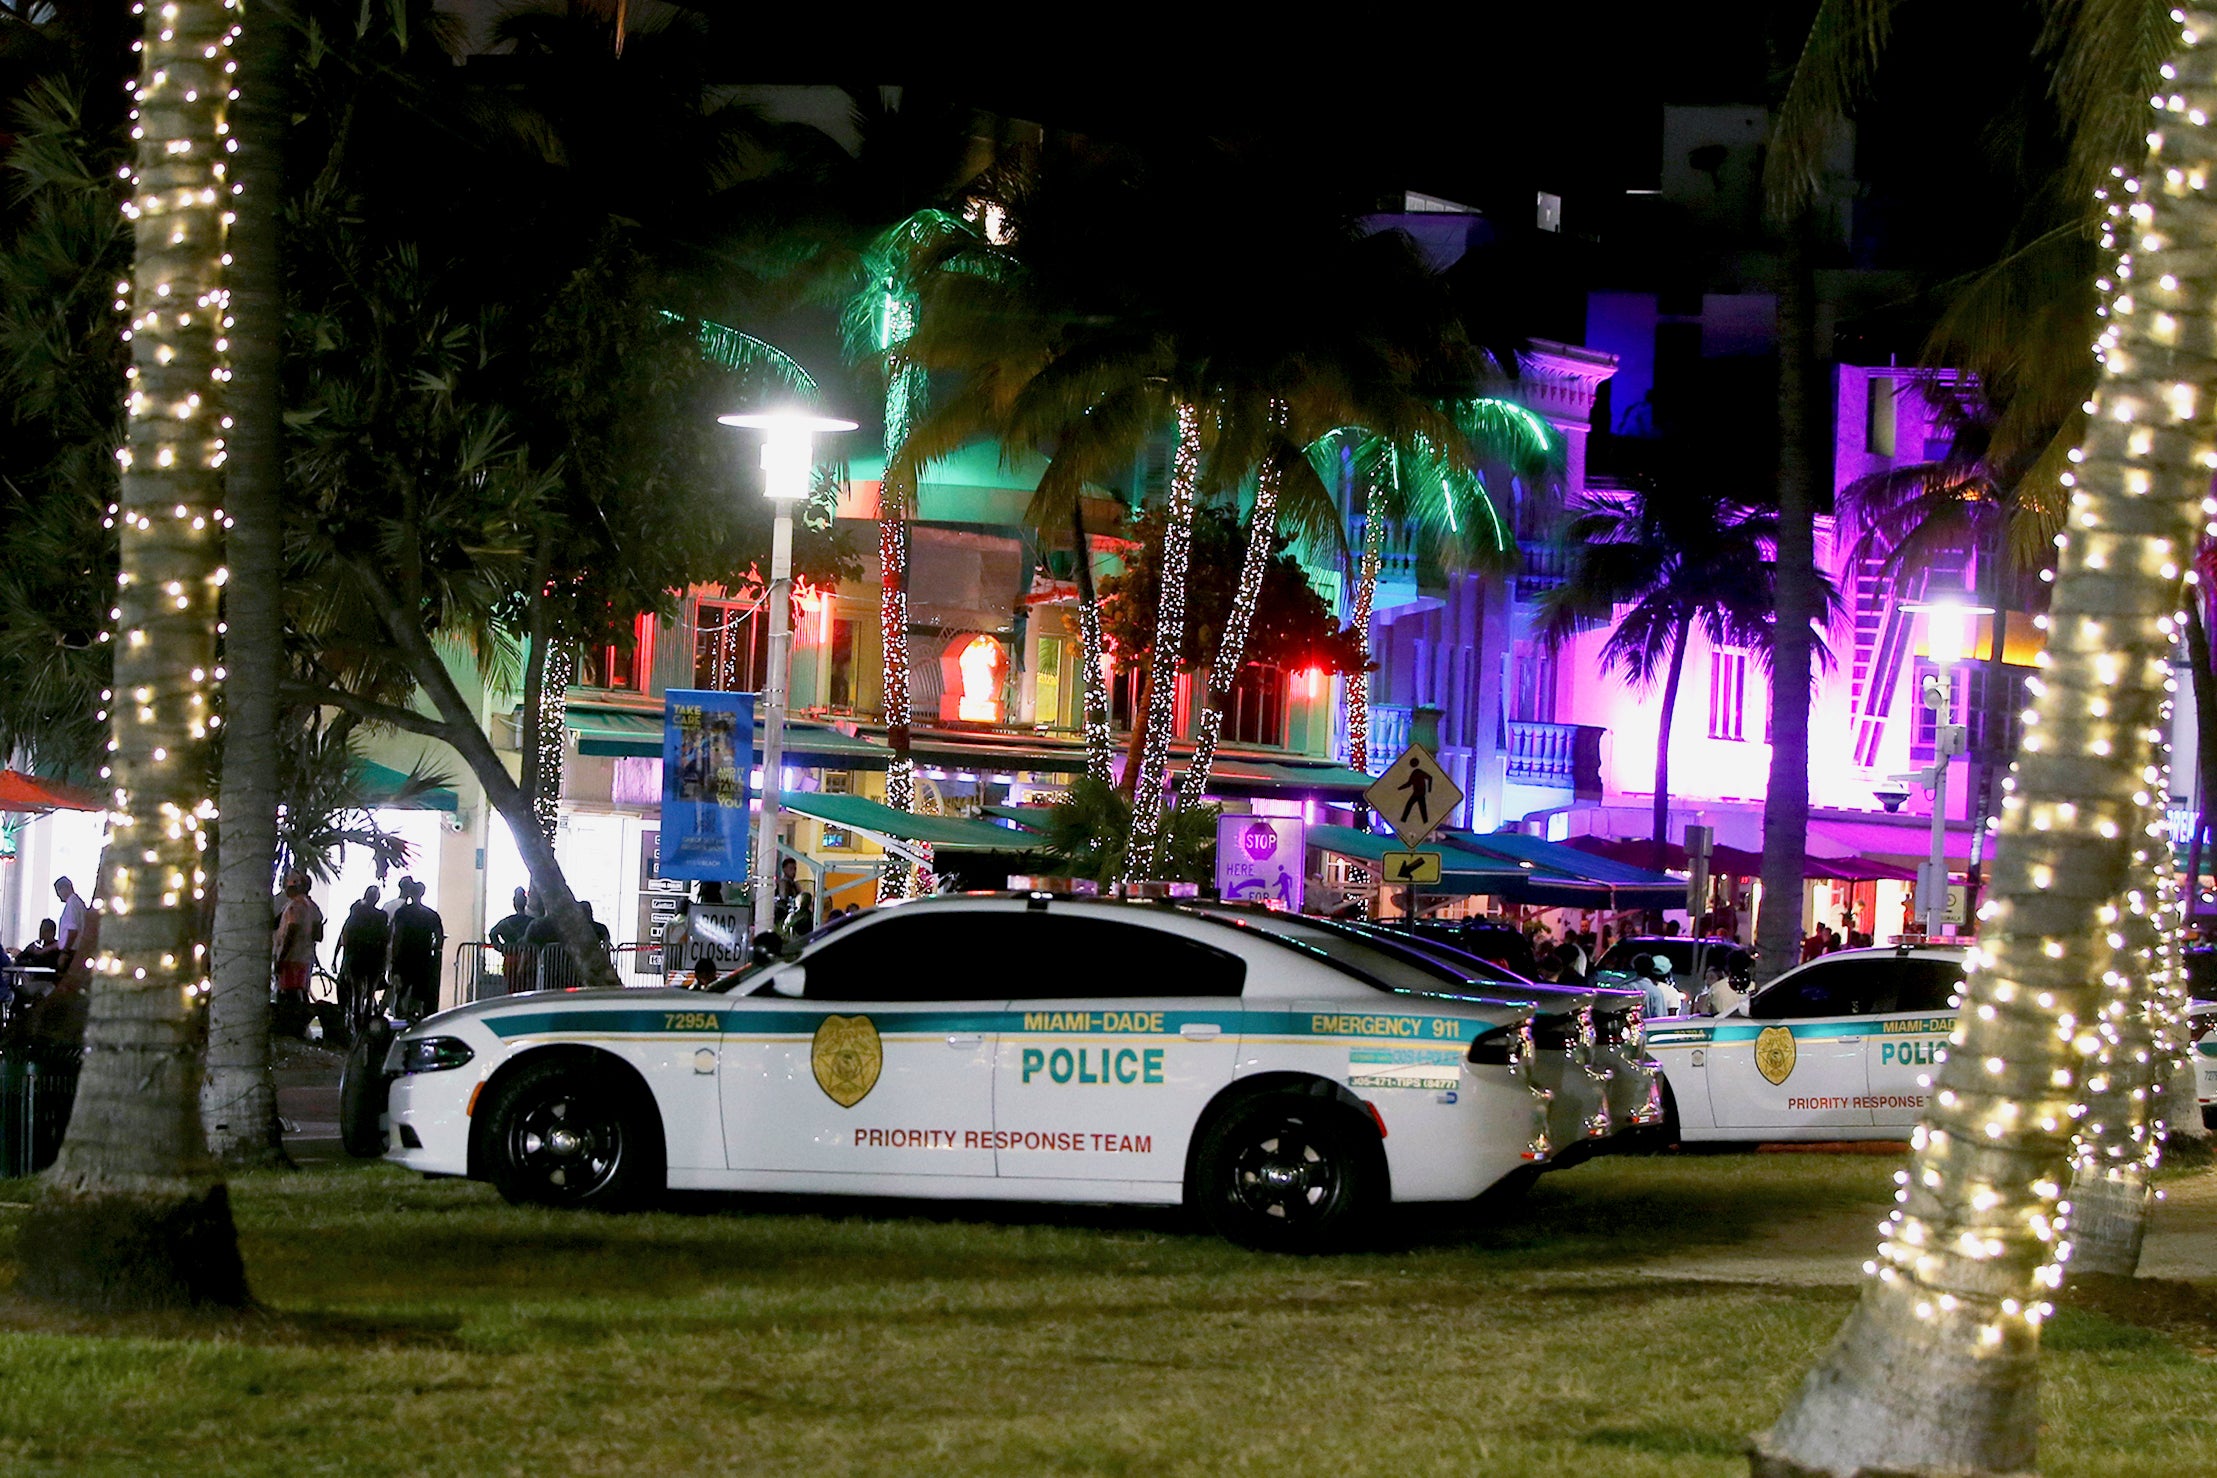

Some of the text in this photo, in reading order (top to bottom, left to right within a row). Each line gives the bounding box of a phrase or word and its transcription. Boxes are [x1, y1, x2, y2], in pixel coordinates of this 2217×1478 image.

[673, 704, 702, 715] TAKE
[672, 715, 702, 725] CARE
[716, 798, 743, 808] YOU
[1245, 834, 1277, 850] STOP
[1226, 864, 1255, 876] HERE
[702, 914, 736, 934] ROAD
[690, 941, 742, 962] CLOSED
[665, 1013, 719, 1030] 7295A
[1024, 1012, 1165, 1033] MIAMI-DADE
[1312, 1014, 1460, 1038] EMERGENCY 911
[1883, 1018, 1956, 1033] MIAMI-DAD
[1022, 1048, 1165, 1085] POLICE
[1423, 1079, 1457, 1089] (8477)
[1788, 1097, 1849, 1110] PRIORITY
[1853, 1095, 1924, 1109] RESPONSE
[855, 1129, 1151, 1153] PRIORITY RESPONSE TEAM
